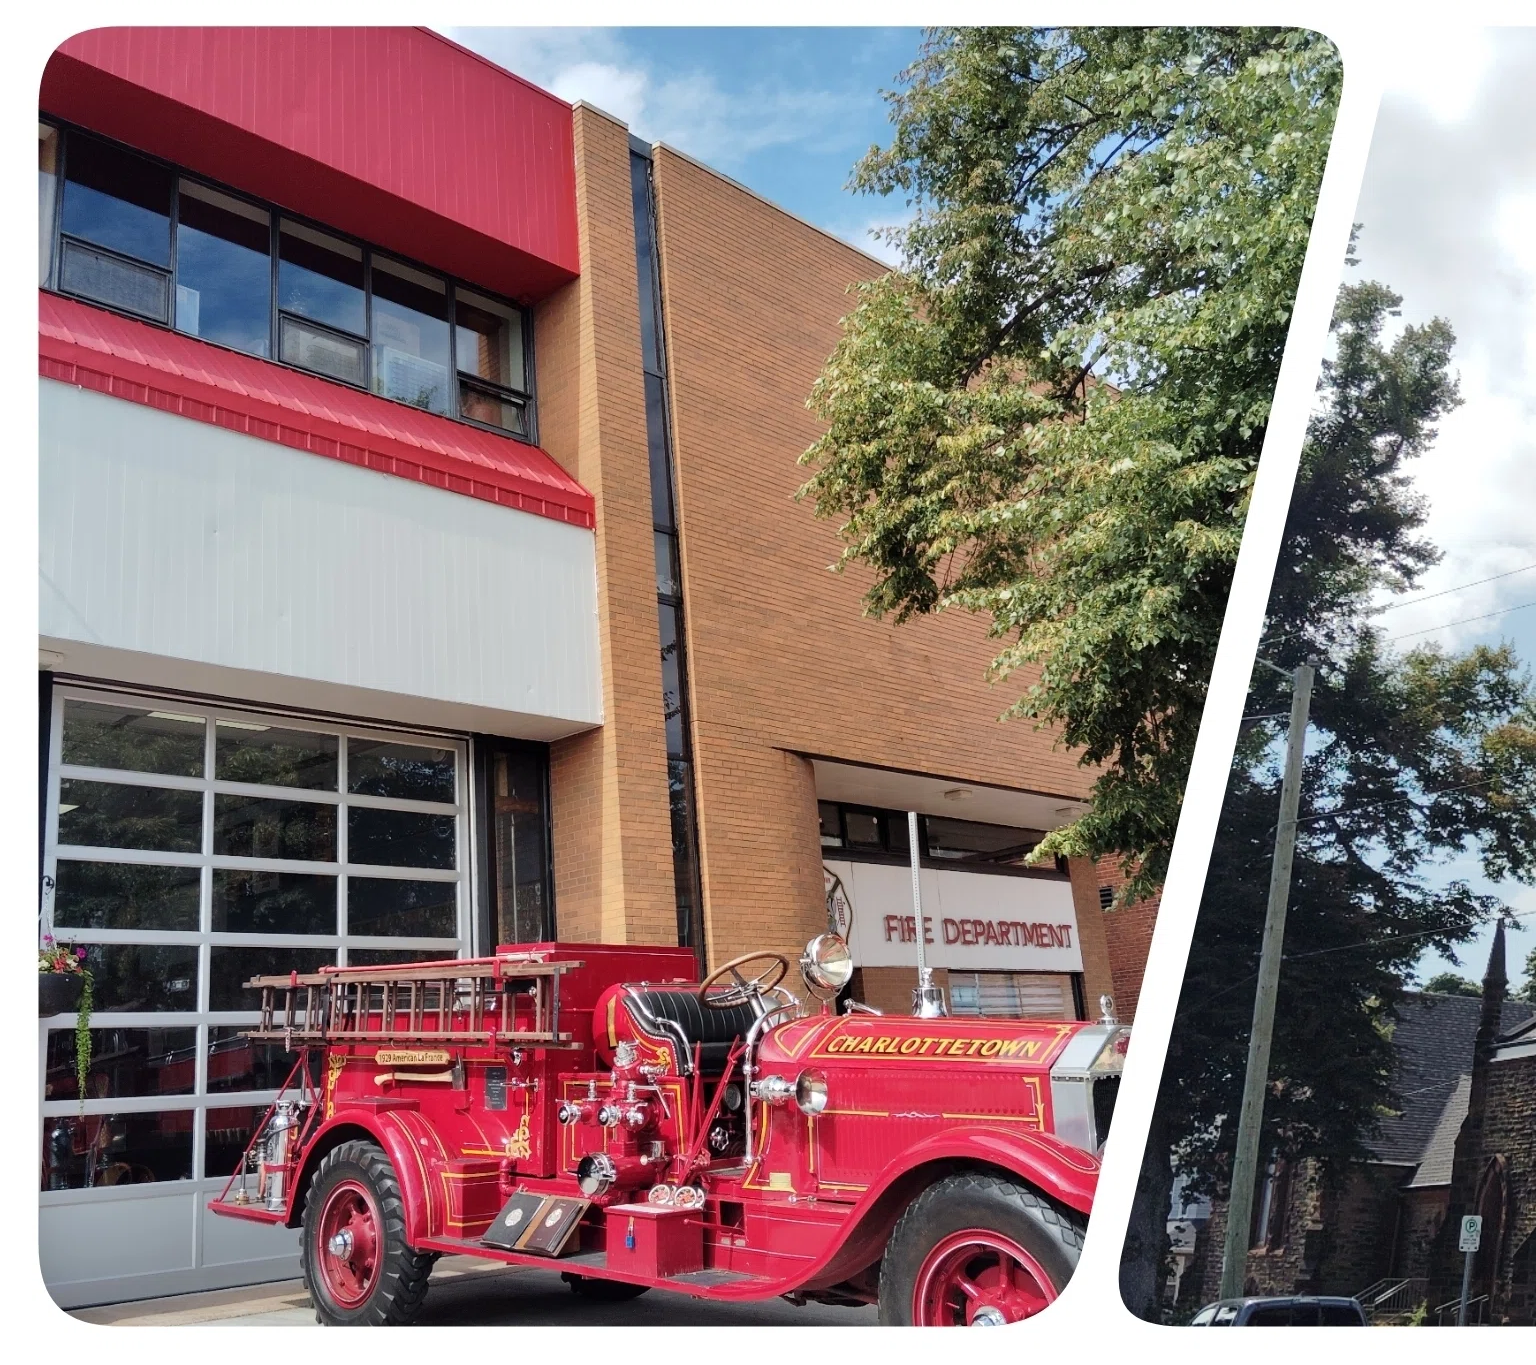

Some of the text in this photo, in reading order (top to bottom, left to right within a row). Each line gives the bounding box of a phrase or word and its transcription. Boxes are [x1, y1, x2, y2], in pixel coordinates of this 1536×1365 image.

[884, 915, 1072, 948] FIRE DEPARTMENT
[379, 1053, 391, 1062] 1929
[392, 1053, 417, 1062] American
[827, 1035, 1041, 1058] CHARLOTTETOWN
